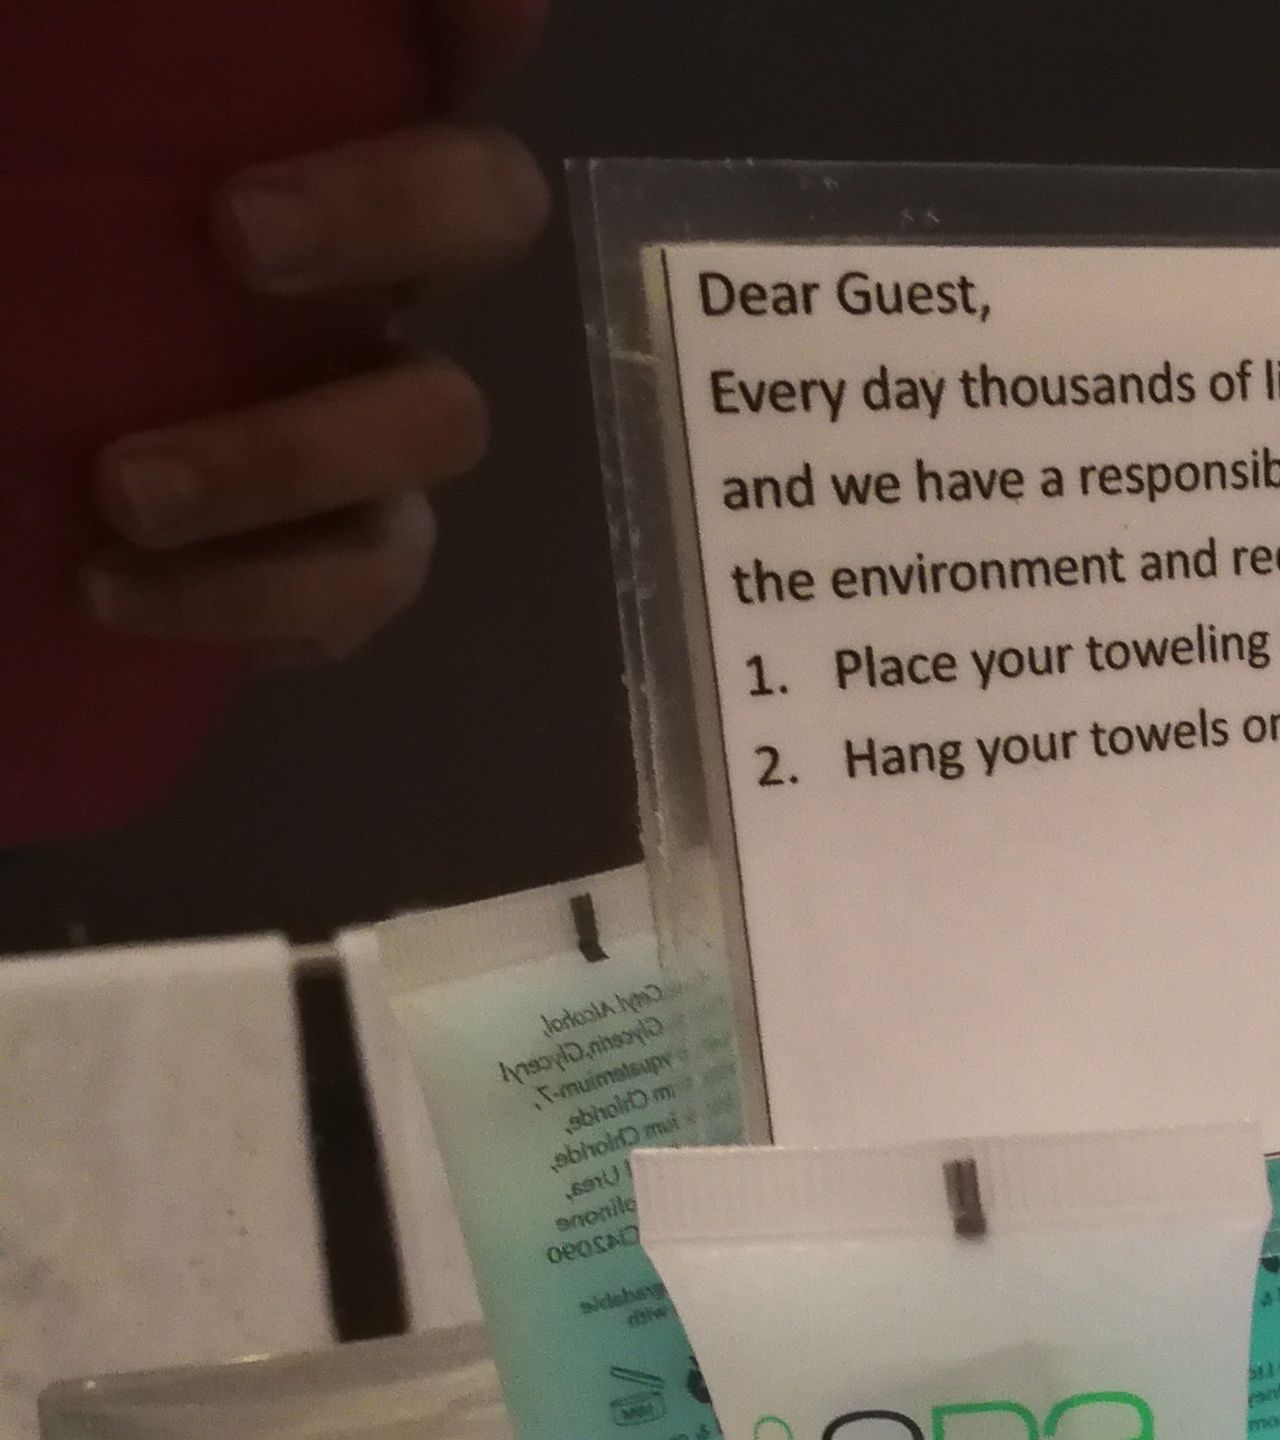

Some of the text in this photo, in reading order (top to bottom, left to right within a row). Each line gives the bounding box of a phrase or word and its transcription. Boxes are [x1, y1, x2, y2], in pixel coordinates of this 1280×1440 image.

[700, 272, 990, 322] Dear Guest,
[710, 370, 846, 423] Every
[862, 364, 946, 420] day
[959, 360, 1196, 409] thousands
[1209, 359, 1253, 403] of
[723, 462, 815, 511] and
[831, 472, 901, 506] we
[916, 458, 1024, 503] have
[1041, 466, 1064, 498] a
[731, 558, 815, 604] the
[831, 547, 1126, 599] environment
[1141, 536, 1217, 582] and
[746, 655, 788, 696] 1.
[835, 645, 957, 690] Place
[971, 644, 1073, 690] your
[1085, 623, 1271, 672] toweling
[755, 745, 798, 787] 2.
[845, 737, 965, 780] Hang
[976, 730, 1078, 777] your
[1089, 707, 1229, 757] towels
